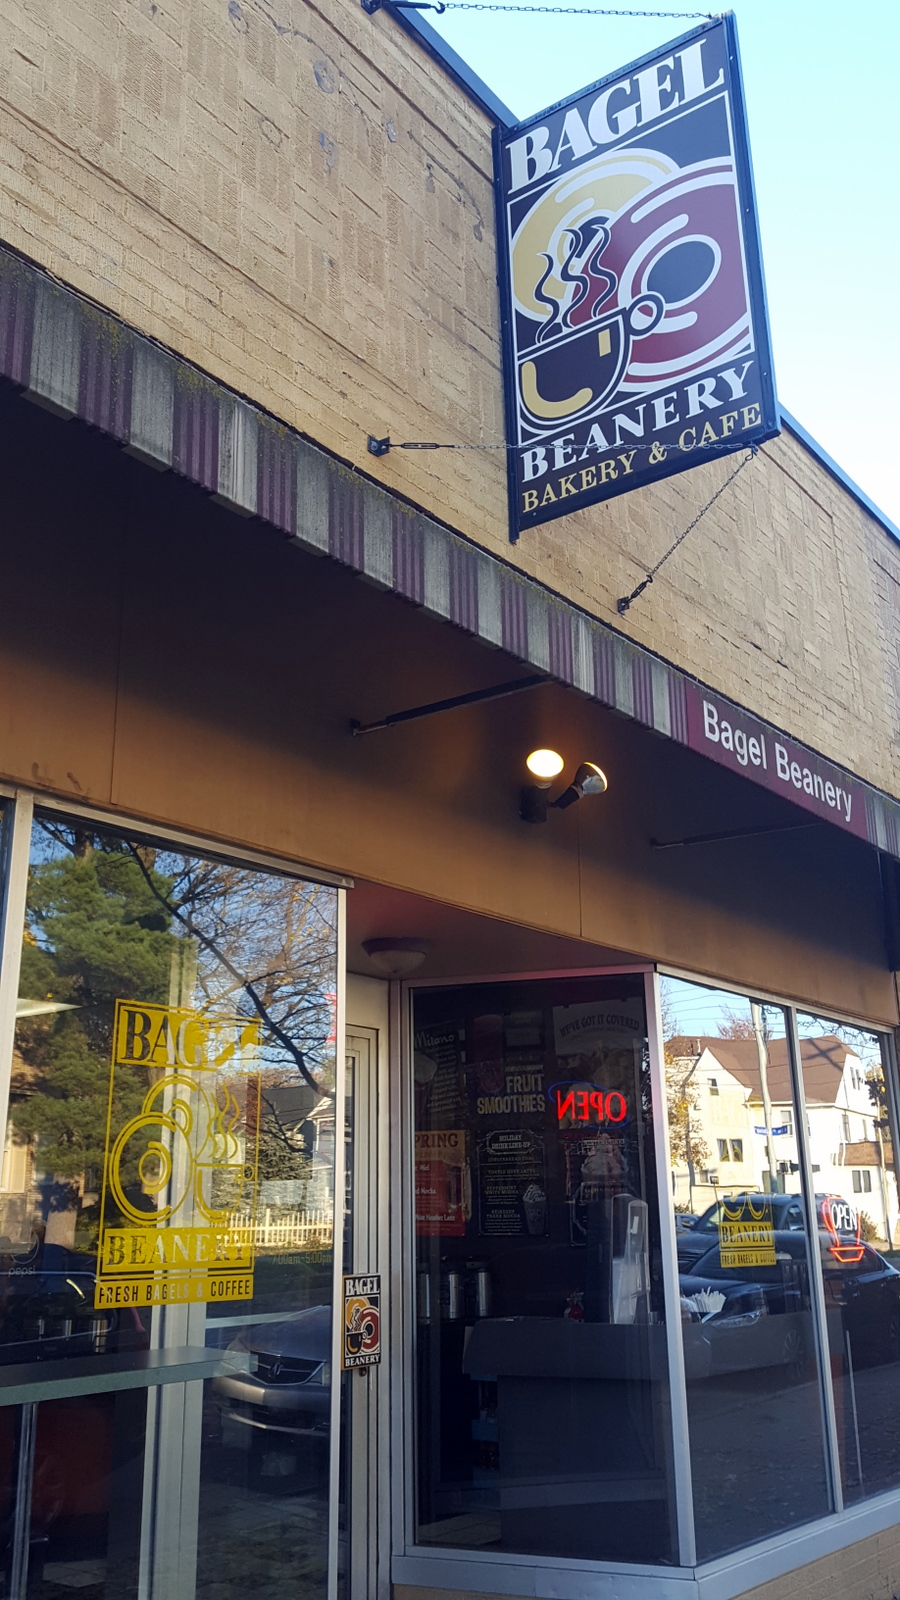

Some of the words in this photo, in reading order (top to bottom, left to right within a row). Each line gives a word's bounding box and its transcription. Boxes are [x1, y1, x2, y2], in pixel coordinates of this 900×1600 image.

[506, 39, 725, 195] BAGEL
[521, 360, 755, 483] BEANERY
[522, 452, 637, 514] BAKERY
[648, 446, 668, 465] &
[678, 403, 762, 452] CAFE
[703, 700, 768, 770] Bagel
[775, 742, 852, 823] Beanery
[581, 1015, 596, 1027] GOT
[597, 1014, 605, 1024] IT
[606, 1014, 640, 1031] COVERED
[123, 1010, 259, 1072] BAG
[506, 1074, 544, 1093] FRUIT
[476, 1094, 546, 1115] SMOOTHIES
[415, 1133, 459, 1148] PRING
[831, 1203, 858, 1231] OPEN
[722, 1224, 772, 1244] BEANERY
[105, 1233, 246, 1266] BEANERY
[722, 1253, 735, 1266] FRESH
[8, 1265, 36, 1279] pepsi
[98, 1285, 139, 1304] FRESH
[145, 1282, 190, 1301] BAGELS
[196, 1282, 204, 1299] &
[210, 1279, 251, 1297] COFFEE
[345, 1277, 380, 1297] BAGEL
[345, 1355, 380, 1367] BEANERY
